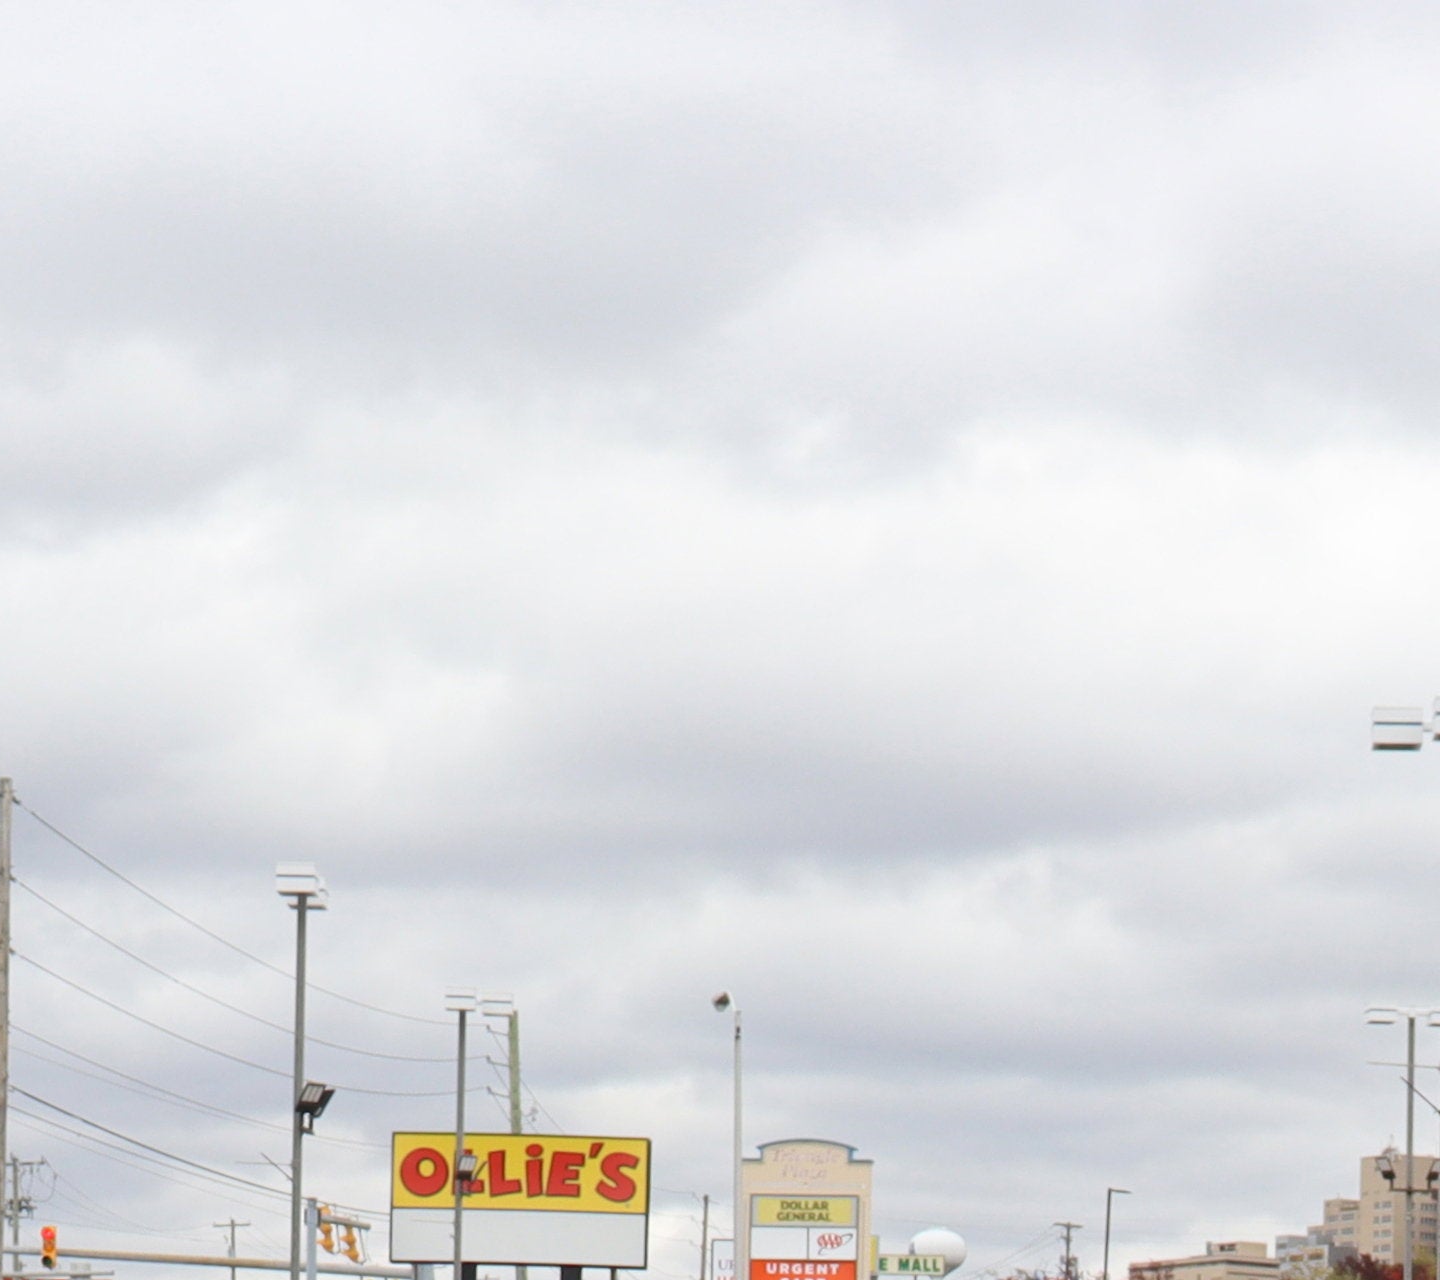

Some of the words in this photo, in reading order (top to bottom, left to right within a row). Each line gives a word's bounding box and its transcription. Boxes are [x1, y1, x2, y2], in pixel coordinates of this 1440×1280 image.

[780, 1200, 830, 1211] DOLLAR
[776, 1211, 831, 1223] GENERAL
[766, 1262, 840, 1275] URGENT
[898, 1257, 942, 1272] MALL
